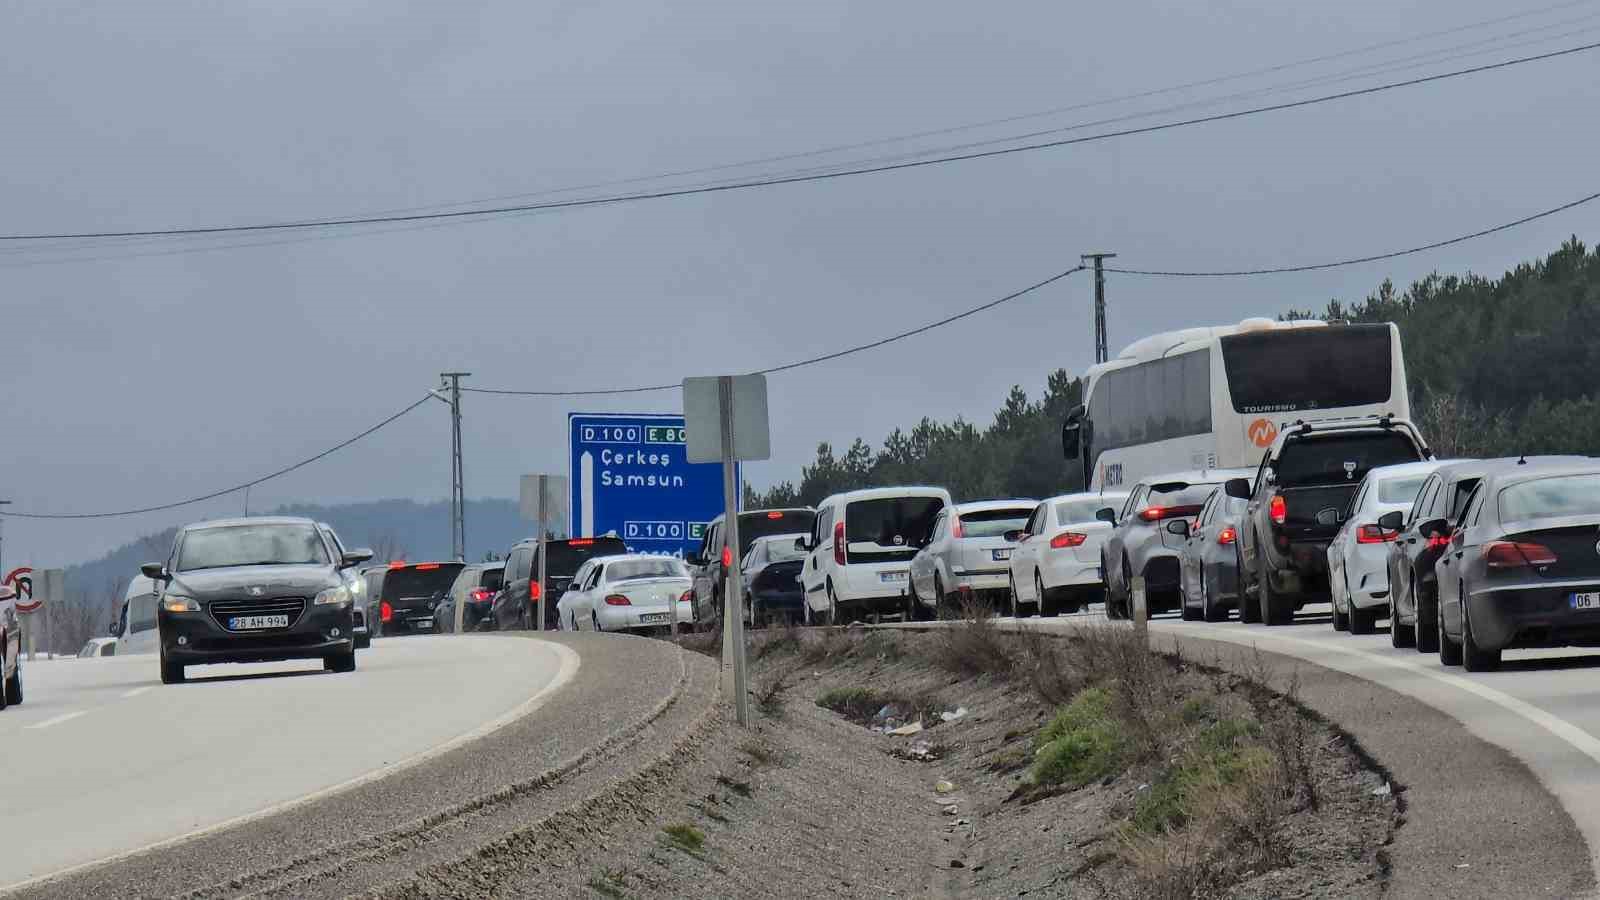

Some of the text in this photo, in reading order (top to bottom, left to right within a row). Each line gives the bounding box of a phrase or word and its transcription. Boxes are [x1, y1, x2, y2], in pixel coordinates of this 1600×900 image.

[1244, 404, 1297, 413] TOURISMO
[585, 428, 687, 441] D.100 E.80
[601, 449, 670, 466] Çerkeş
[601, 470, 683, 486] Samsun
[629, 524, 680, 537] D.100
[1577, 594, 1591, 608] 06
